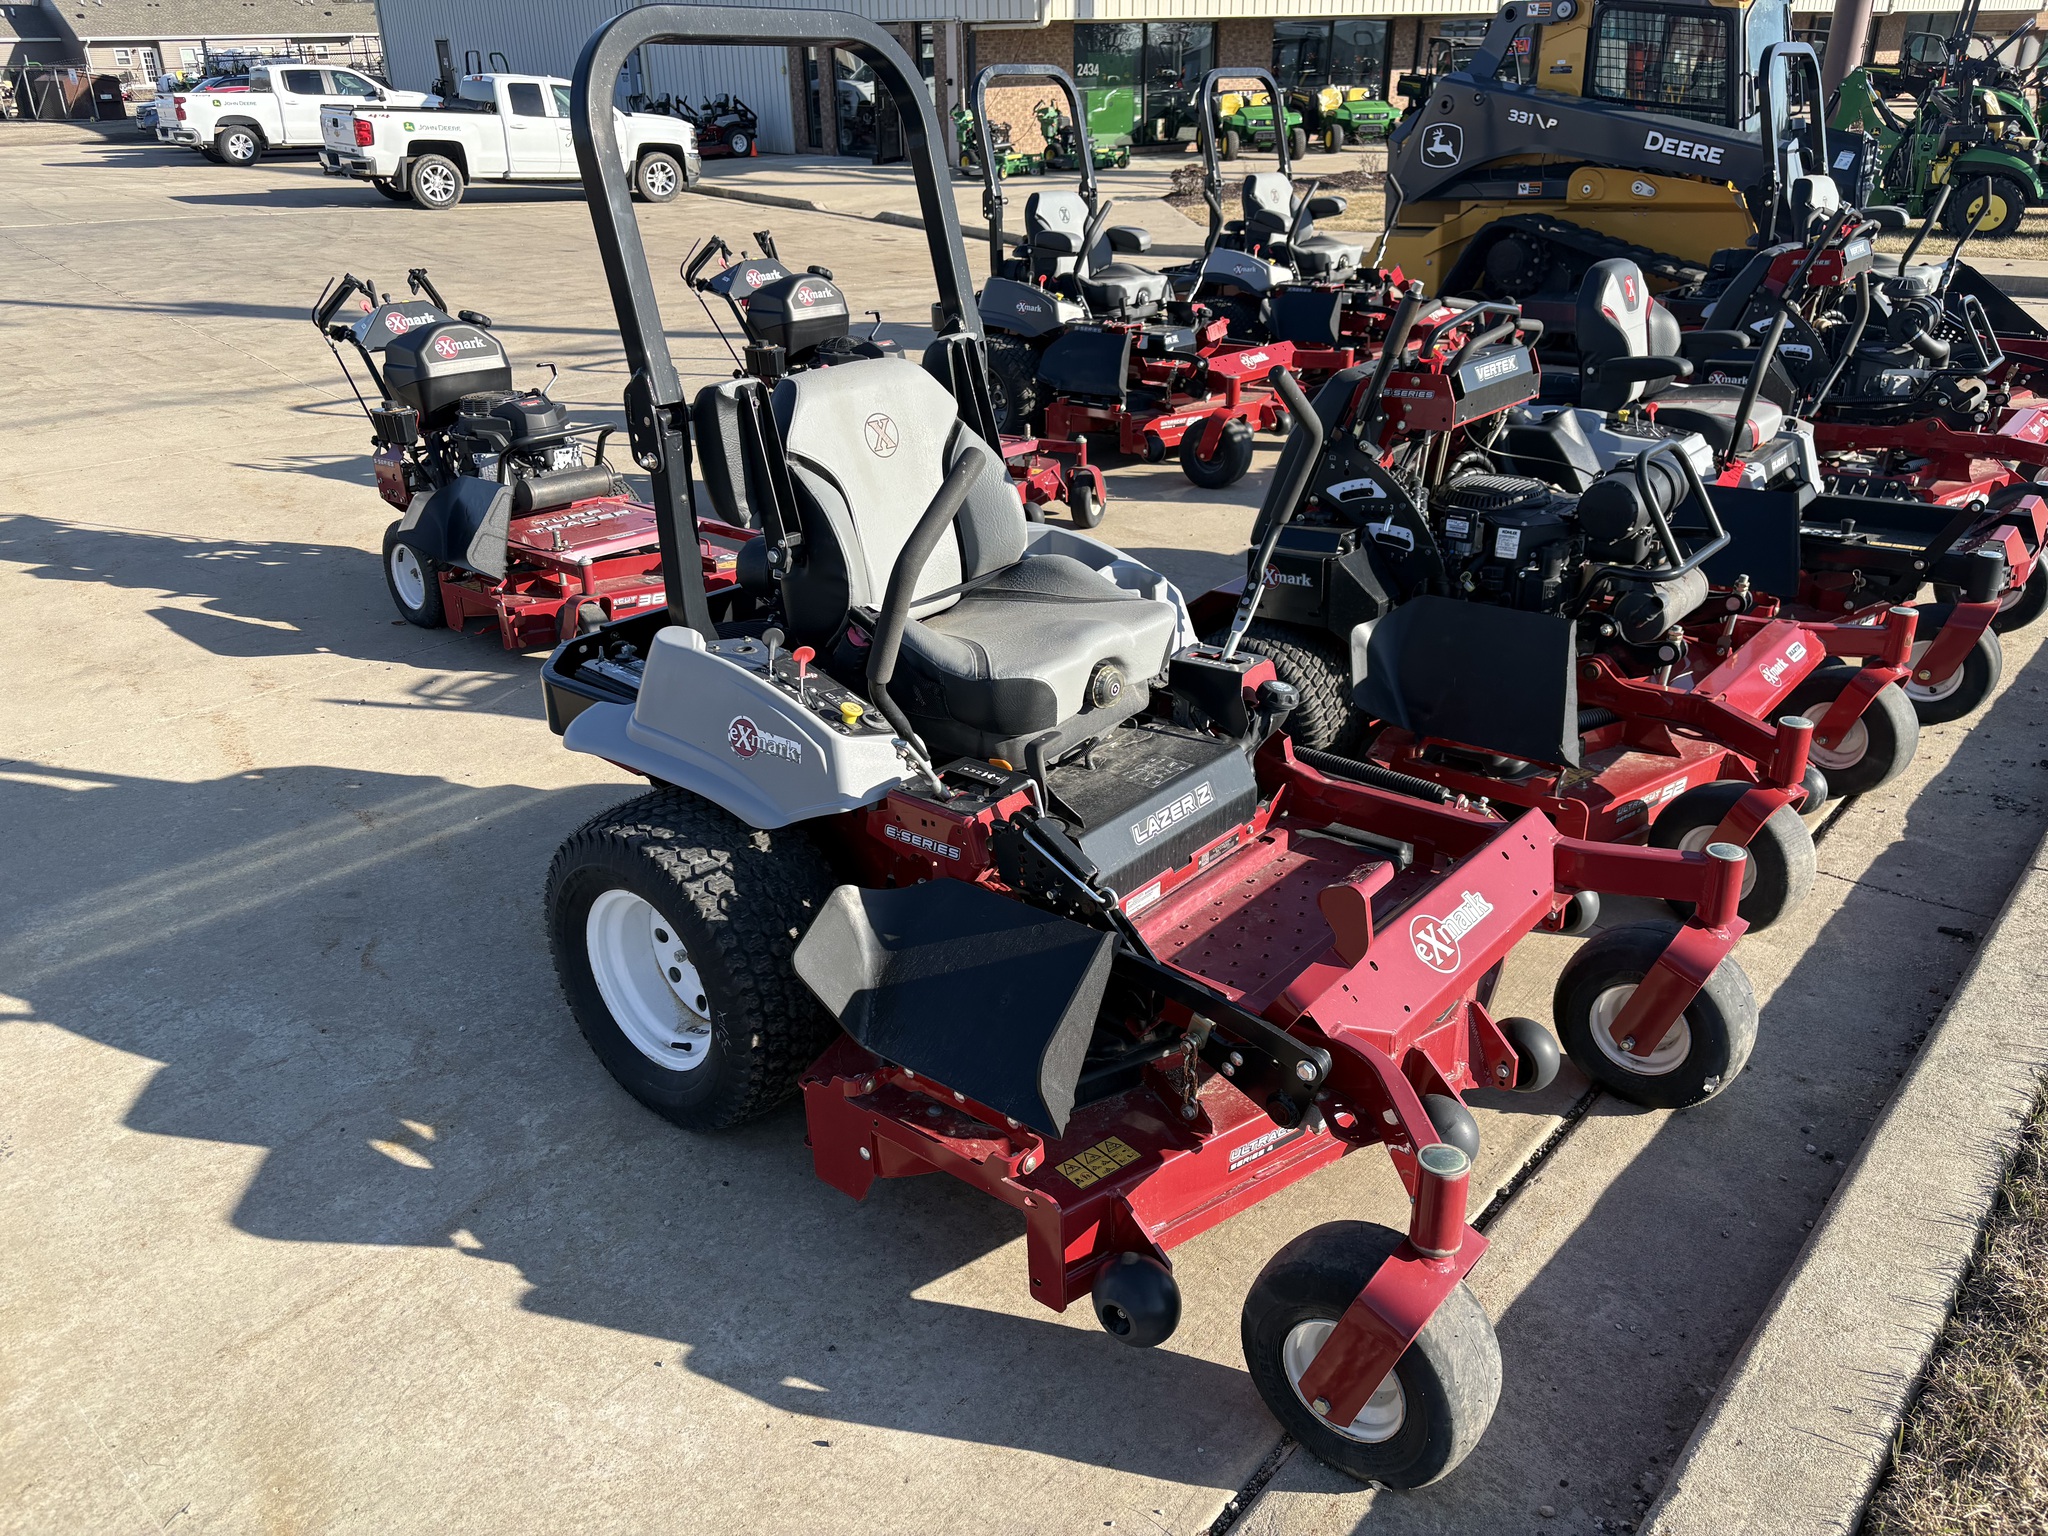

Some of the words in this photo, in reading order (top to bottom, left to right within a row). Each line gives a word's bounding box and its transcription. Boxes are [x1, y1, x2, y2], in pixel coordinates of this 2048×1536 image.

[1077, 62, 1100, 77] 2434
[1507, 108, 1534, 126] 331
[418, 124, 437, 132] JOHN
[437, 124, 462, 133] DEERE
[1644, 130, 1725, 166] DEERE
[746, 269, 783, 288] eXmark
[1233, 265, 1257, 274] eXmark
[798, 287, 834, 306] eXmark
[1016, 302, 1042, 314] eXmark
[385, 312, 436, 333] eXmark
[434, 336, 488, 358] eXmark
[1474, 354, 1519, 382] VERTEX
[1708, 372, 1749, 385] eXmark
[527, 509, 632, 535] TRACER
[532, 508, 602, 527] TURF
[1263, 568, 1313, 588] Xmark
[1763, 658, 1789, 684] eXmark
[728, 722, 802, 764] eXmark
[1660, 776, 1688, 803] 52
[1132, 793, 1198, 845] LAZER
[1195, 781, 1215, 809] Z
[885, 824, 961, 861] E-SERIES
[1411, 890, 1494, 968] eXmark
[1229, 1127, 1298, 1163] ULTRAC
[1230, 1149, 1265, 1171] SERIES
